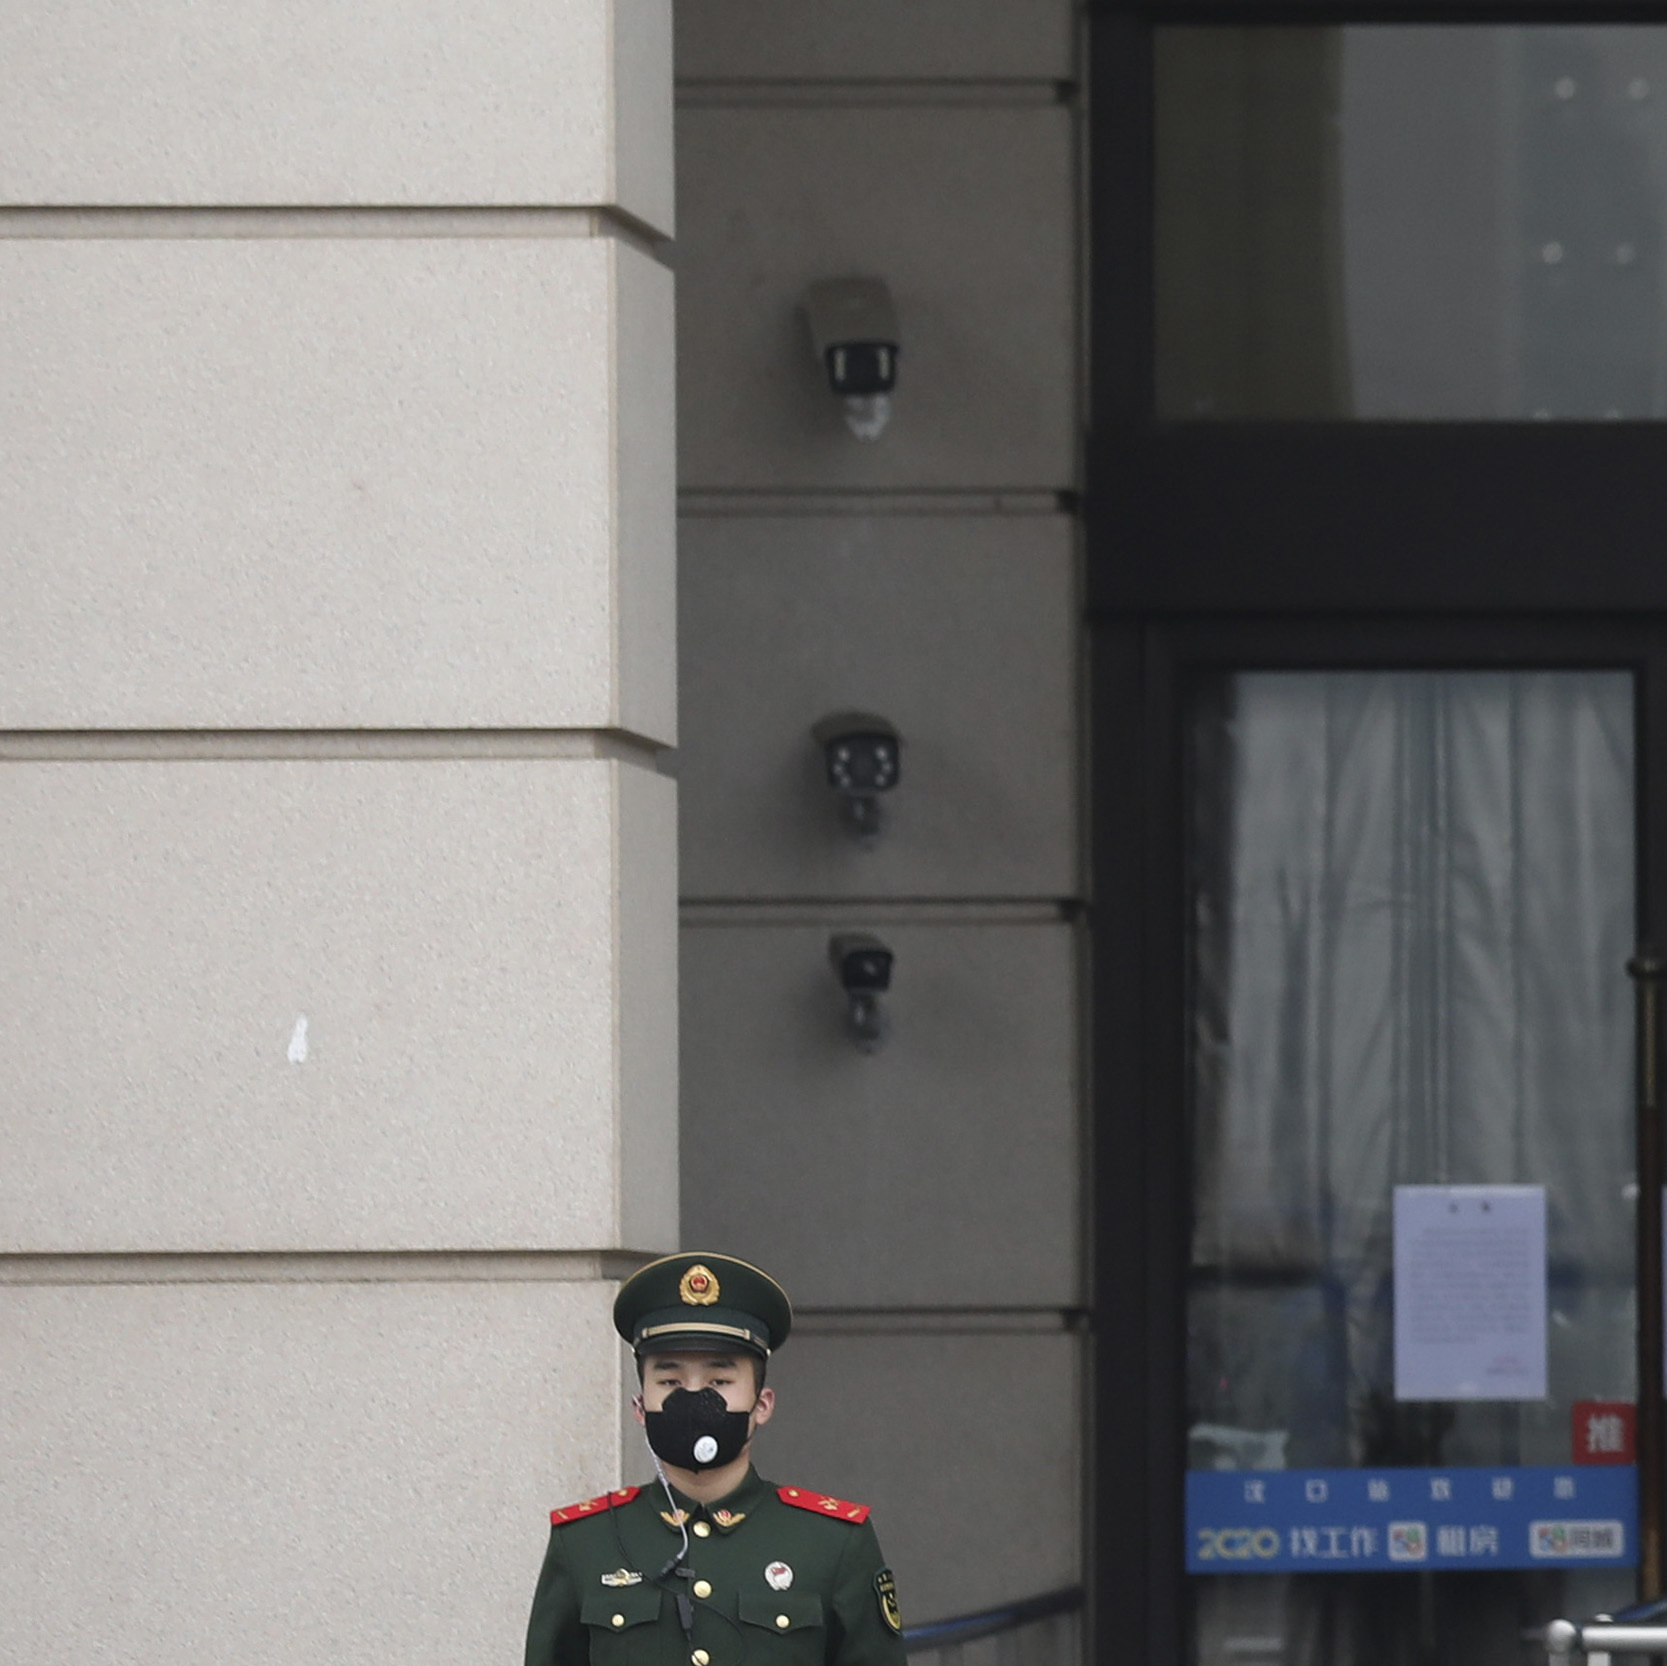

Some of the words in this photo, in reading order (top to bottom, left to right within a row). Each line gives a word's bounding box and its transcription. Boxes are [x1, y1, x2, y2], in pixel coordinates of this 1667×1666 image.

[1197, 1527, 1281, 1560] 2020
[1289, 1525, 1378, 1559] 找工作
